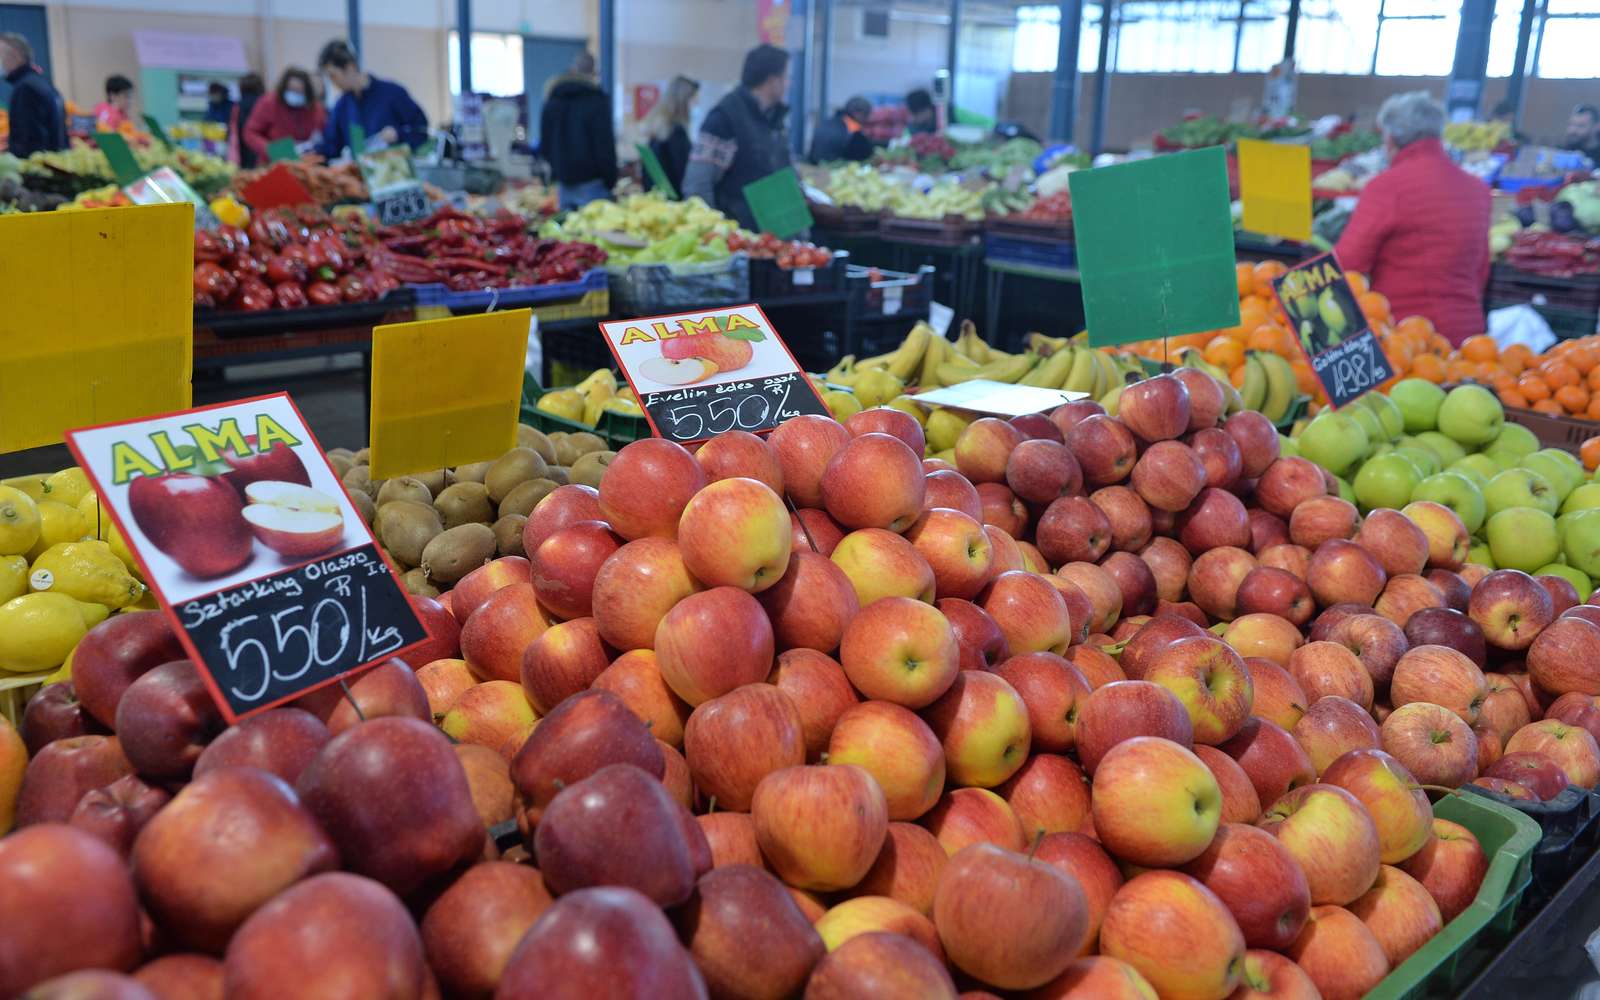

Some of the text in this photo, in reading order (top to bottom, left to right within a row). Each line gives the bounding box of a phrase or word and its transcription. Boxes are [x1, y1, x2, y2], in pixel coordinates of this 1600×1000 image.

[1279, 262, 1343, 304] ALMA
[620, 313, 760, 346] ALMA
[646, 389, 708, 407] Evelin
[111, 412, 303, 486] ALMA
[183, 577, 304, 629] Sztarking
